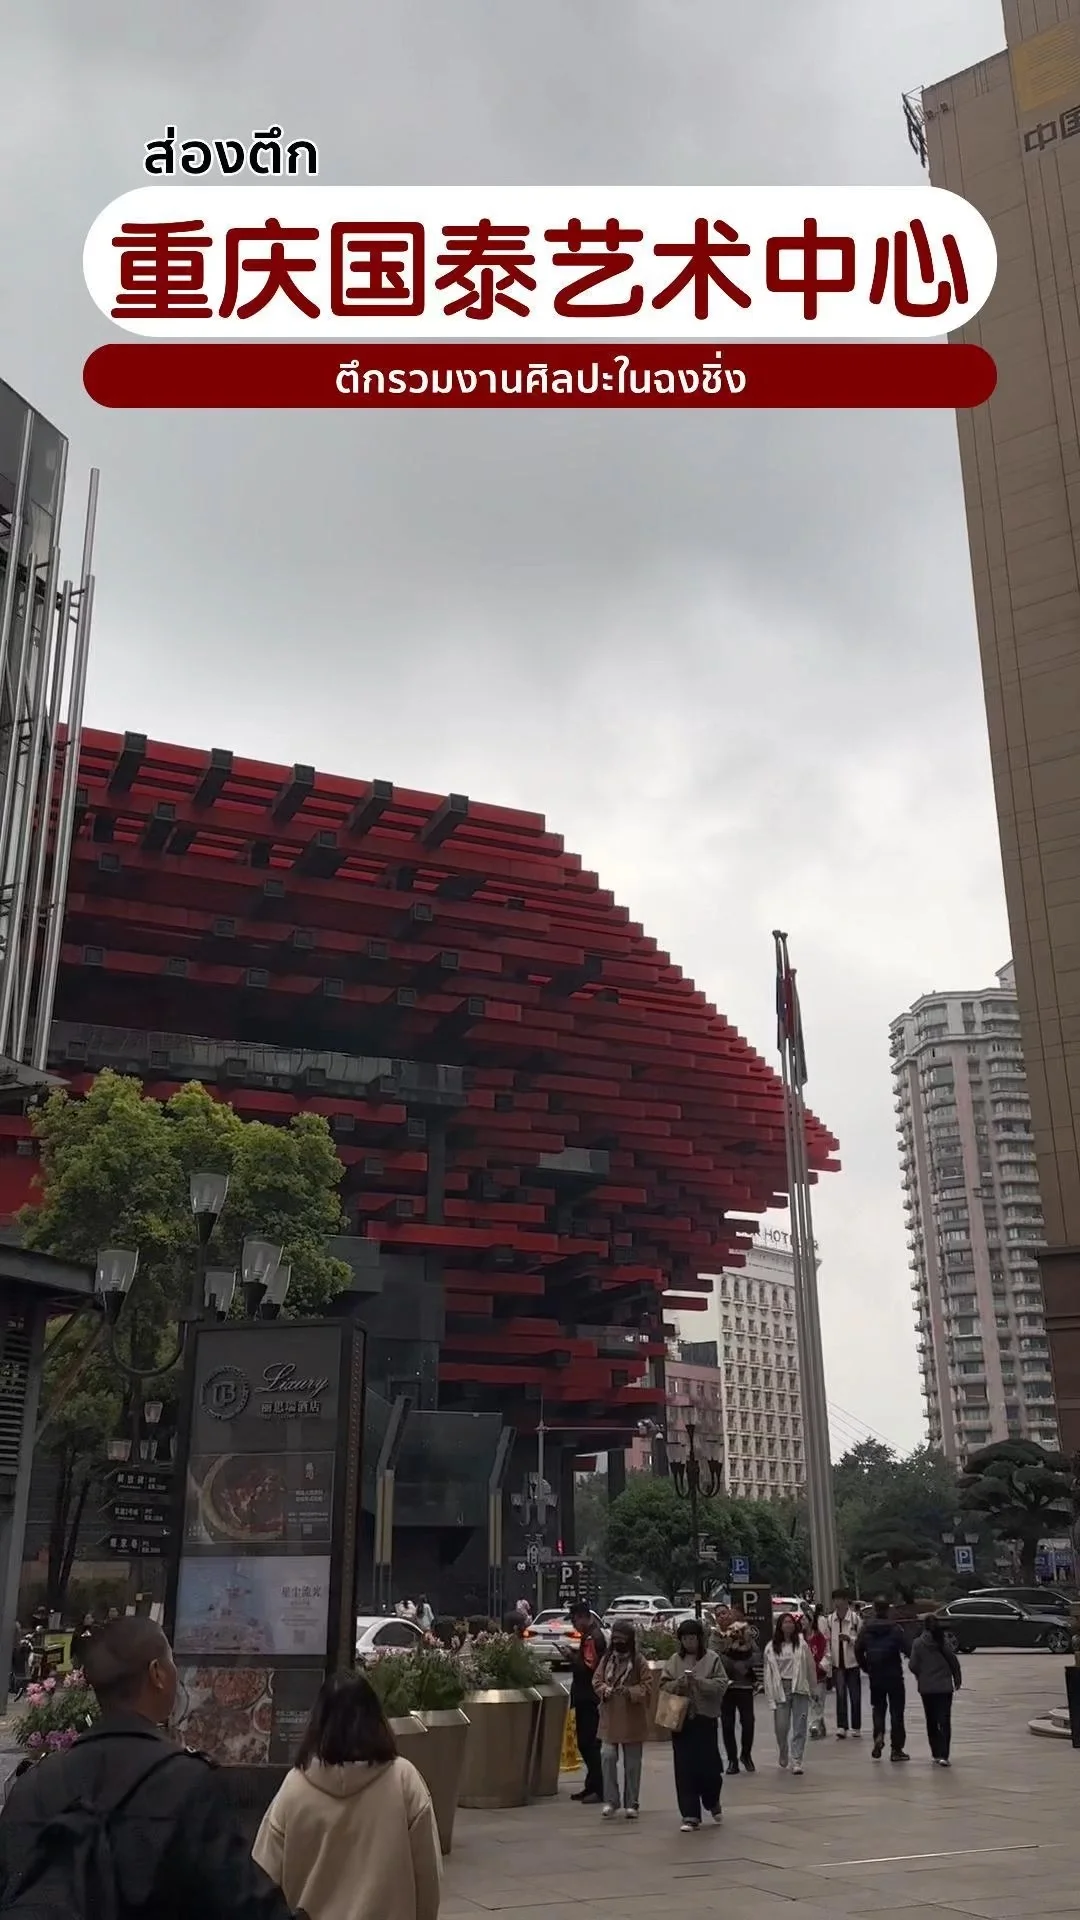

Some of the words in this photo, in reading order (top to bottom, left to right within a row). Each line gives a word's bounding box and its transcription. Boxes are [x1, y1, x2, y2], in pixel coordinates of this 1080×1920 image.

[959, 1551, 968, 1563] P
[562, 1567, 573, 1583] P
[743, 1591, 758, 1614] P
